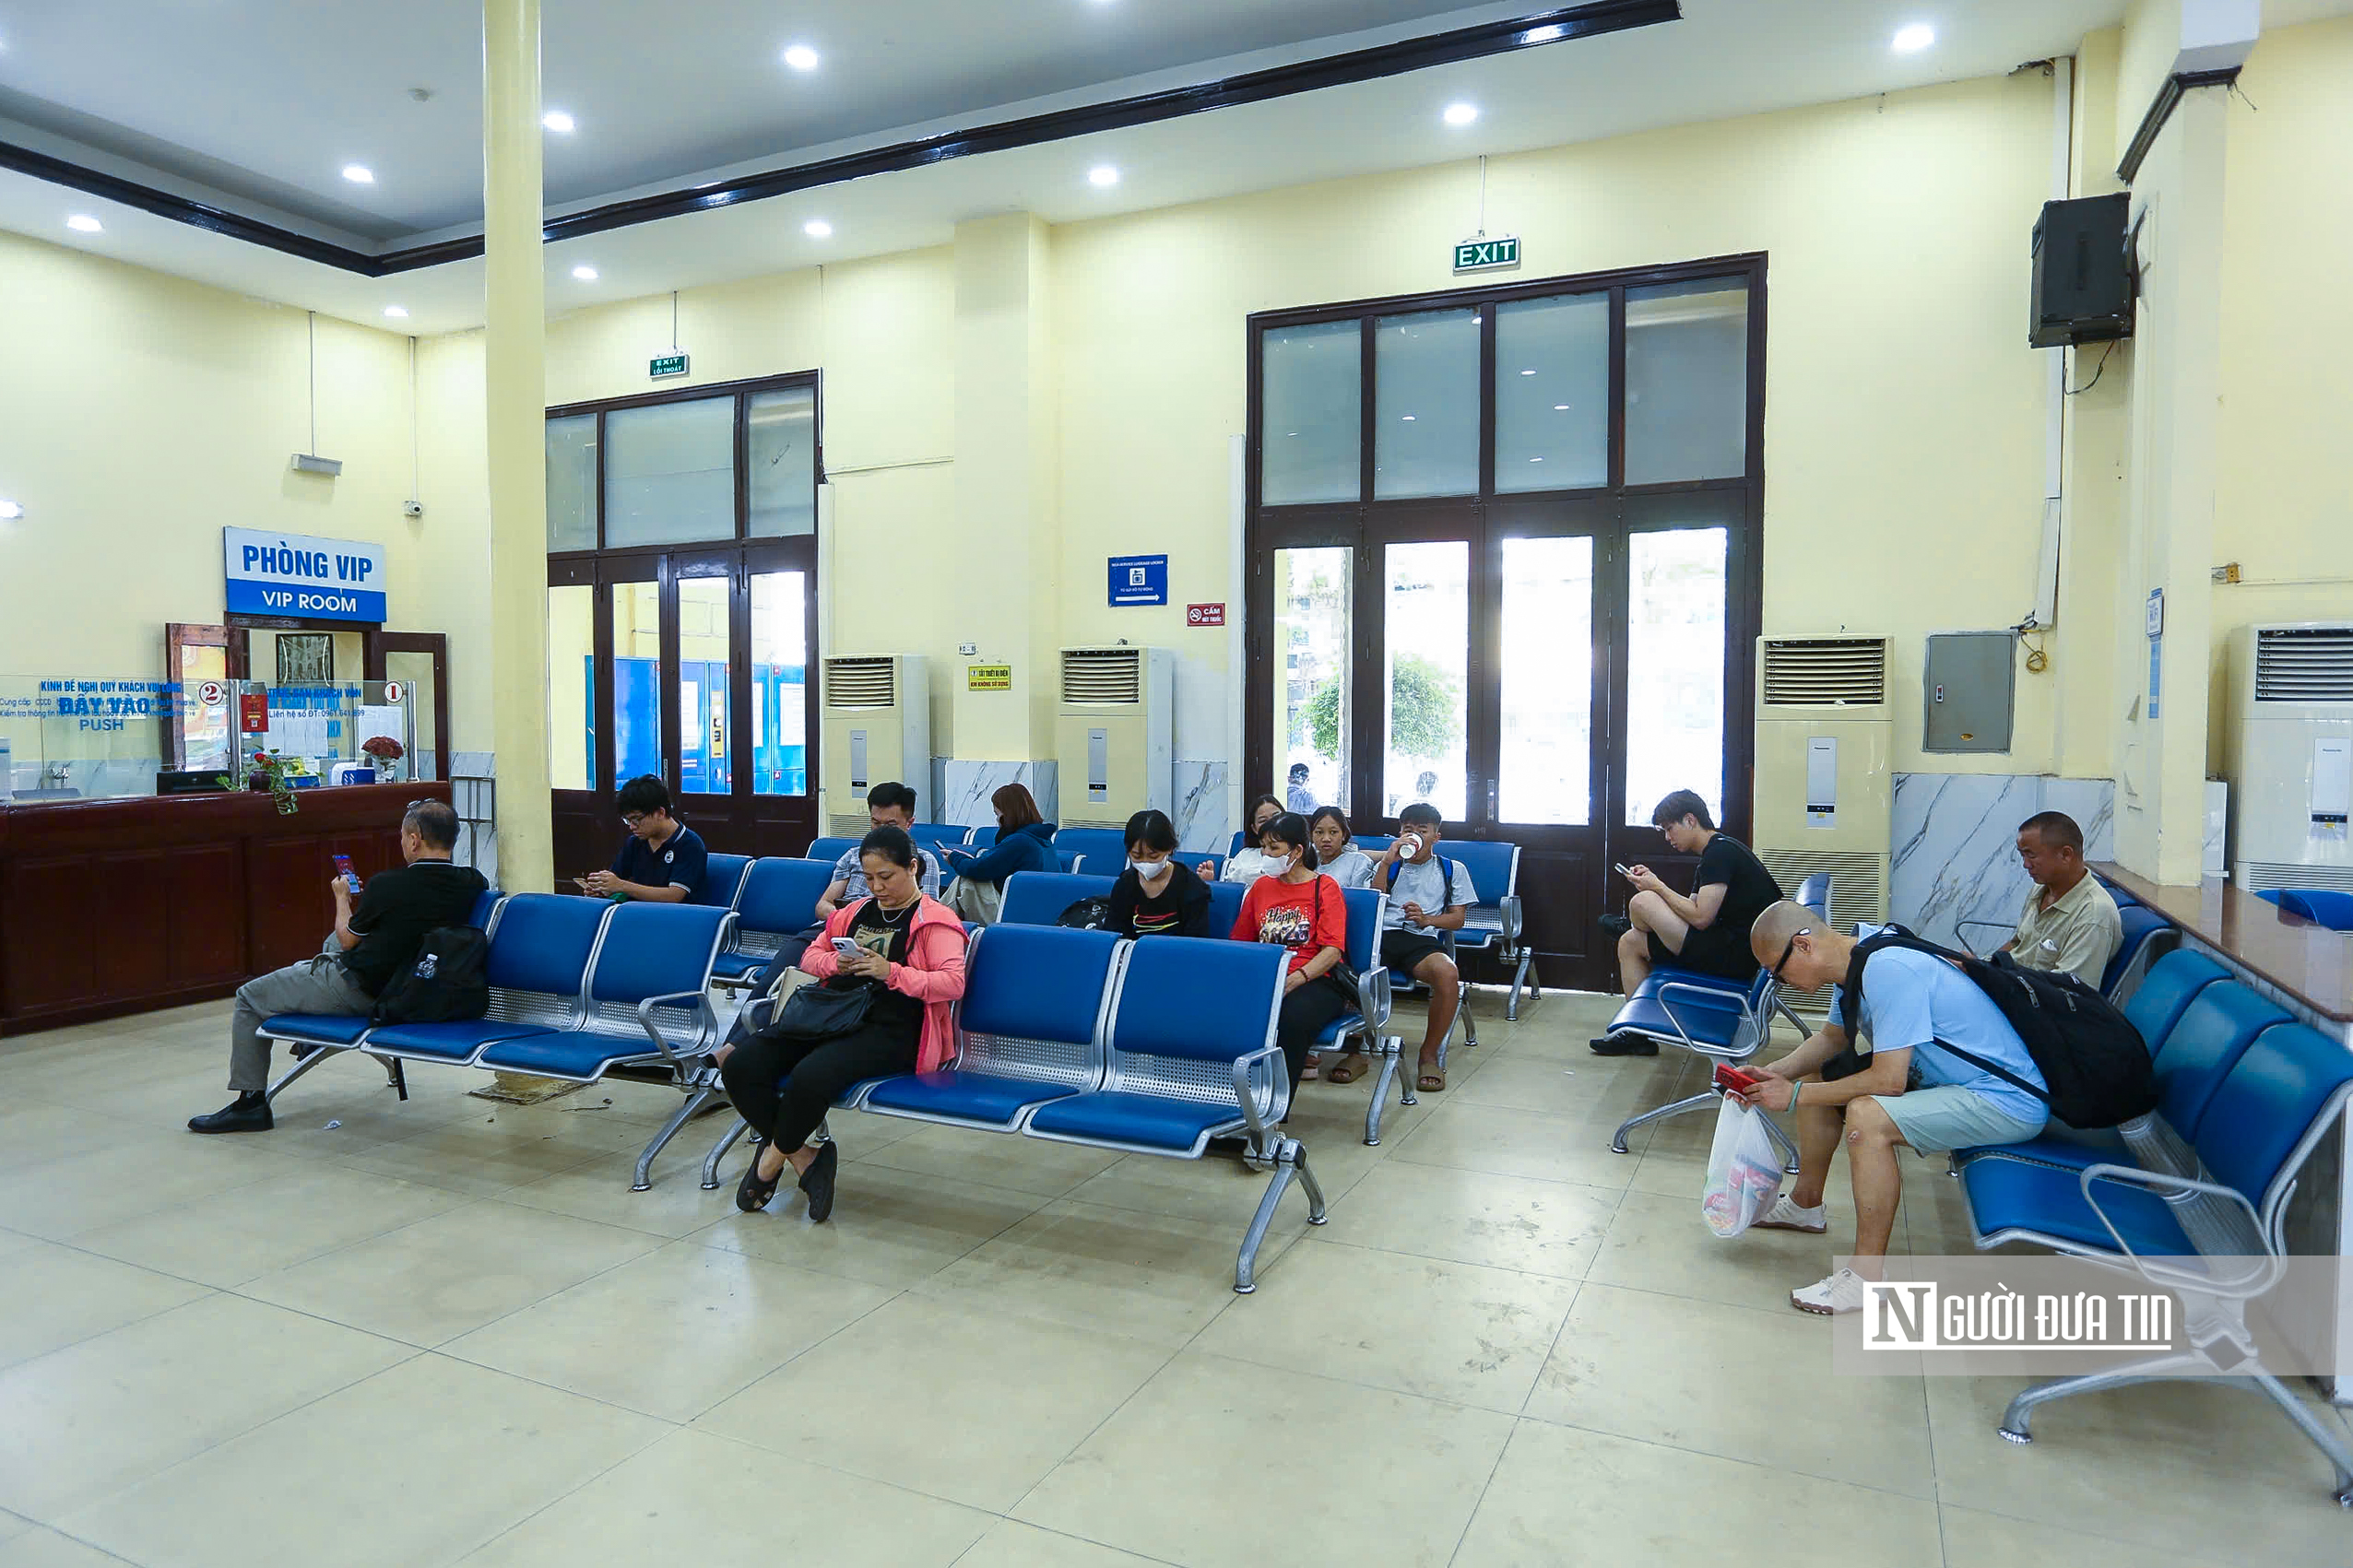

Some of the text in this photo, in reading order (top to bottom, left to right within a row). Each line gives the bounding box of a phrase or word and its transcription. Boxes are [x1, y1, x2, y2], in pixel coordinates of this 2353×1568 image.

[1459, 241, 1515, 266] EXIT
[656, 358, 679, 366] EXIT
[242, 540, 372, 582] PHÒNG VIP
[262, 590, 357, 612] VIP ROOM
[1203, 605, 1220, 615] CẤM
[41, 678, 63, 692] KÍNH
[77, 680, 98, 693] NGHỊ
[118, 678, 145, 693] KHÁCH
[205, 685, 219, 701] 2
[389, 685, 398, 699] 1
[79, 718, 124, 731] PUSH
[1265, 905, 1301, 925] Happy
